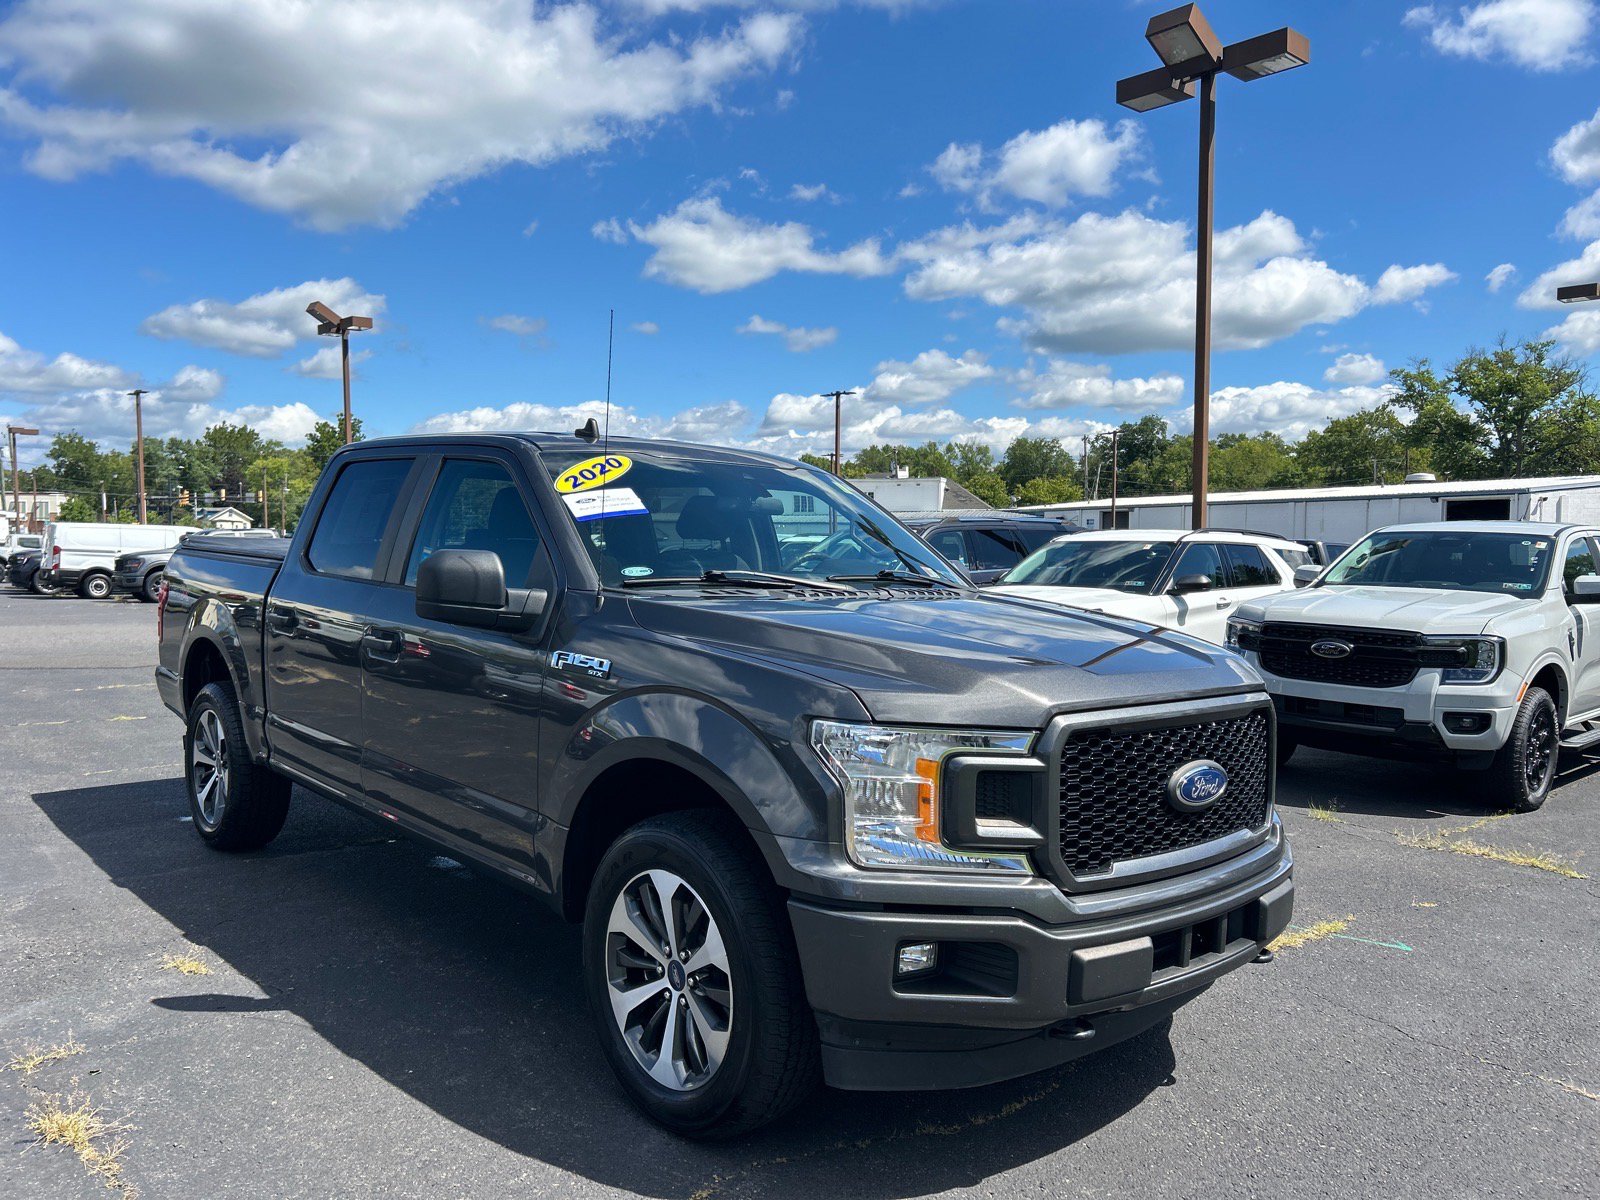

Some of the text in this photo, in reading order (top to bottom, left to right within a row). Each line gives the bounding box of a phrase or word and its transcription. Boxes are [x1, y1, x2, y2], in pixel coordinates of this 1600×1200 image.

[564, 458, 623, 489] 2020
[587, 669, 604, 678] STX
[1191, 774, 1220, 799] Ford
